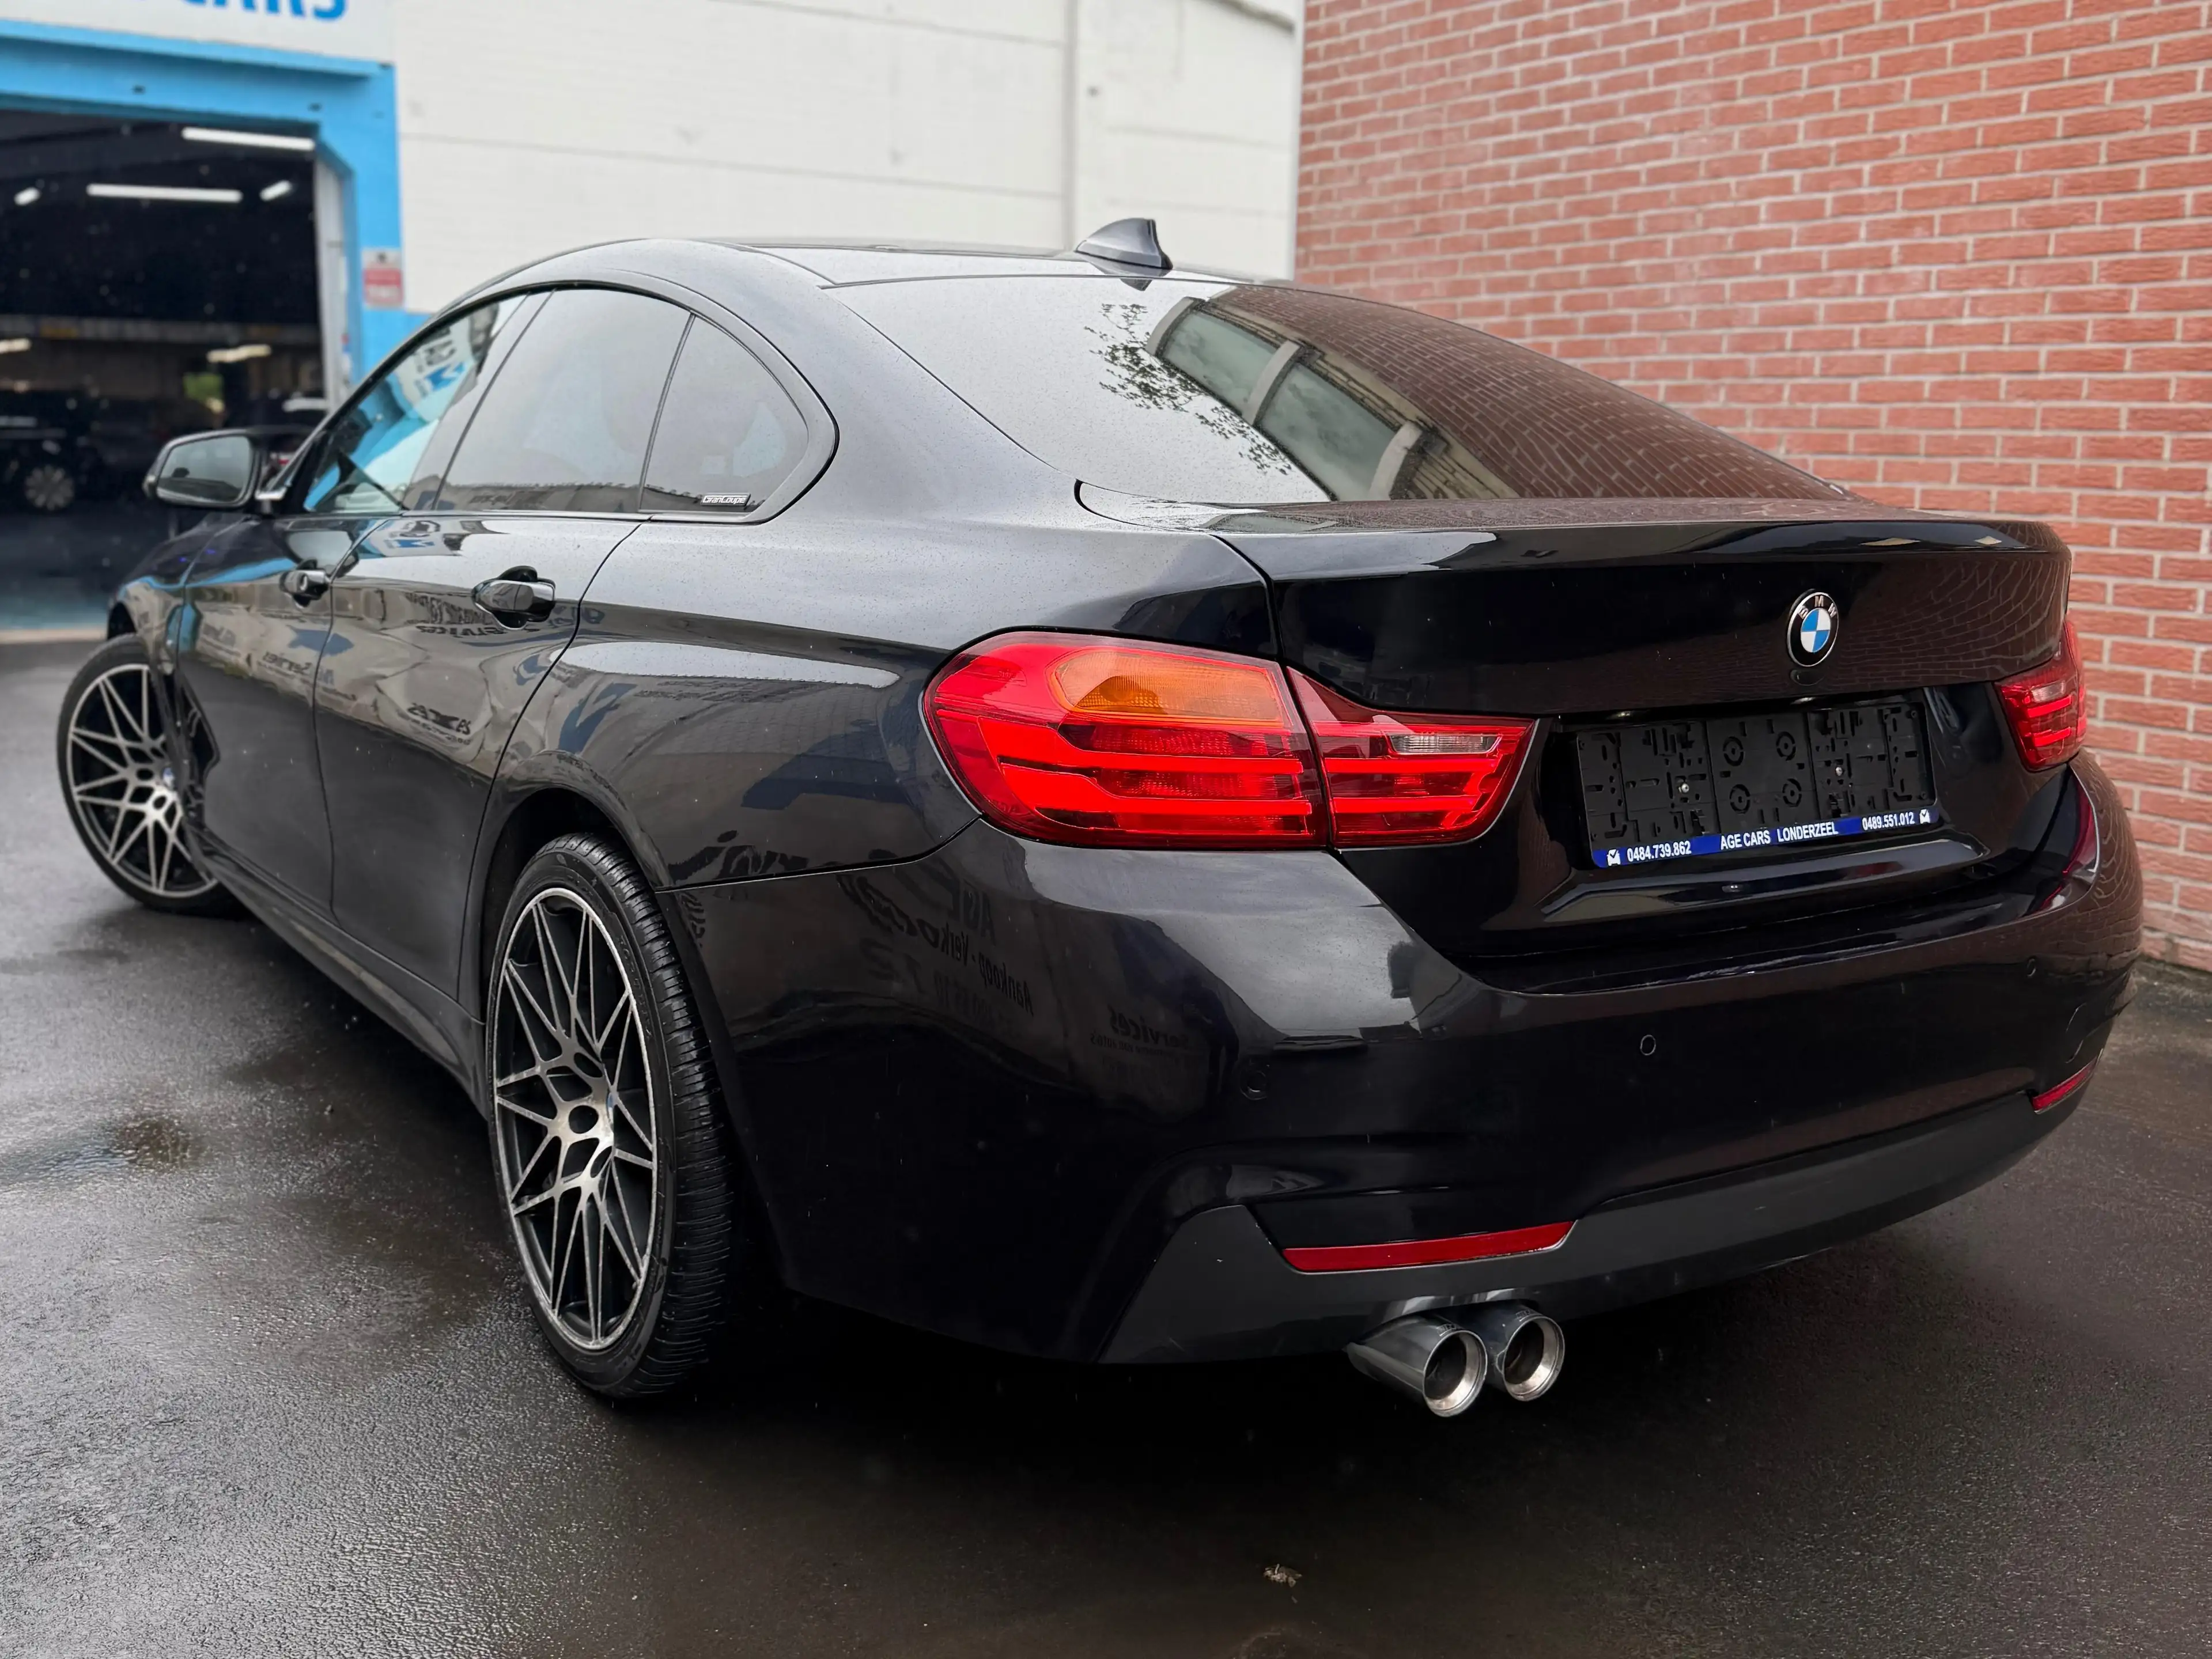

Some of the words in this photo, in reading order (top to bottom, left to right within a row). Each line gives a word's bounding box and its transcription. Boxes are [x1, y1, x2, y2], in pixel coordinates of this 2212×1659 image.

[1798, 595, 1837, 619] BMW
[1627, 840, 1692, 862] 0484.739.862
[1720, 834, 1742, 850] AGE
[1743, 830, 1771, 847] CARS
[1776, 821, 1839, 842] LONDERZEEL
[1862, 812, 1915, 831] 0489.551.012
